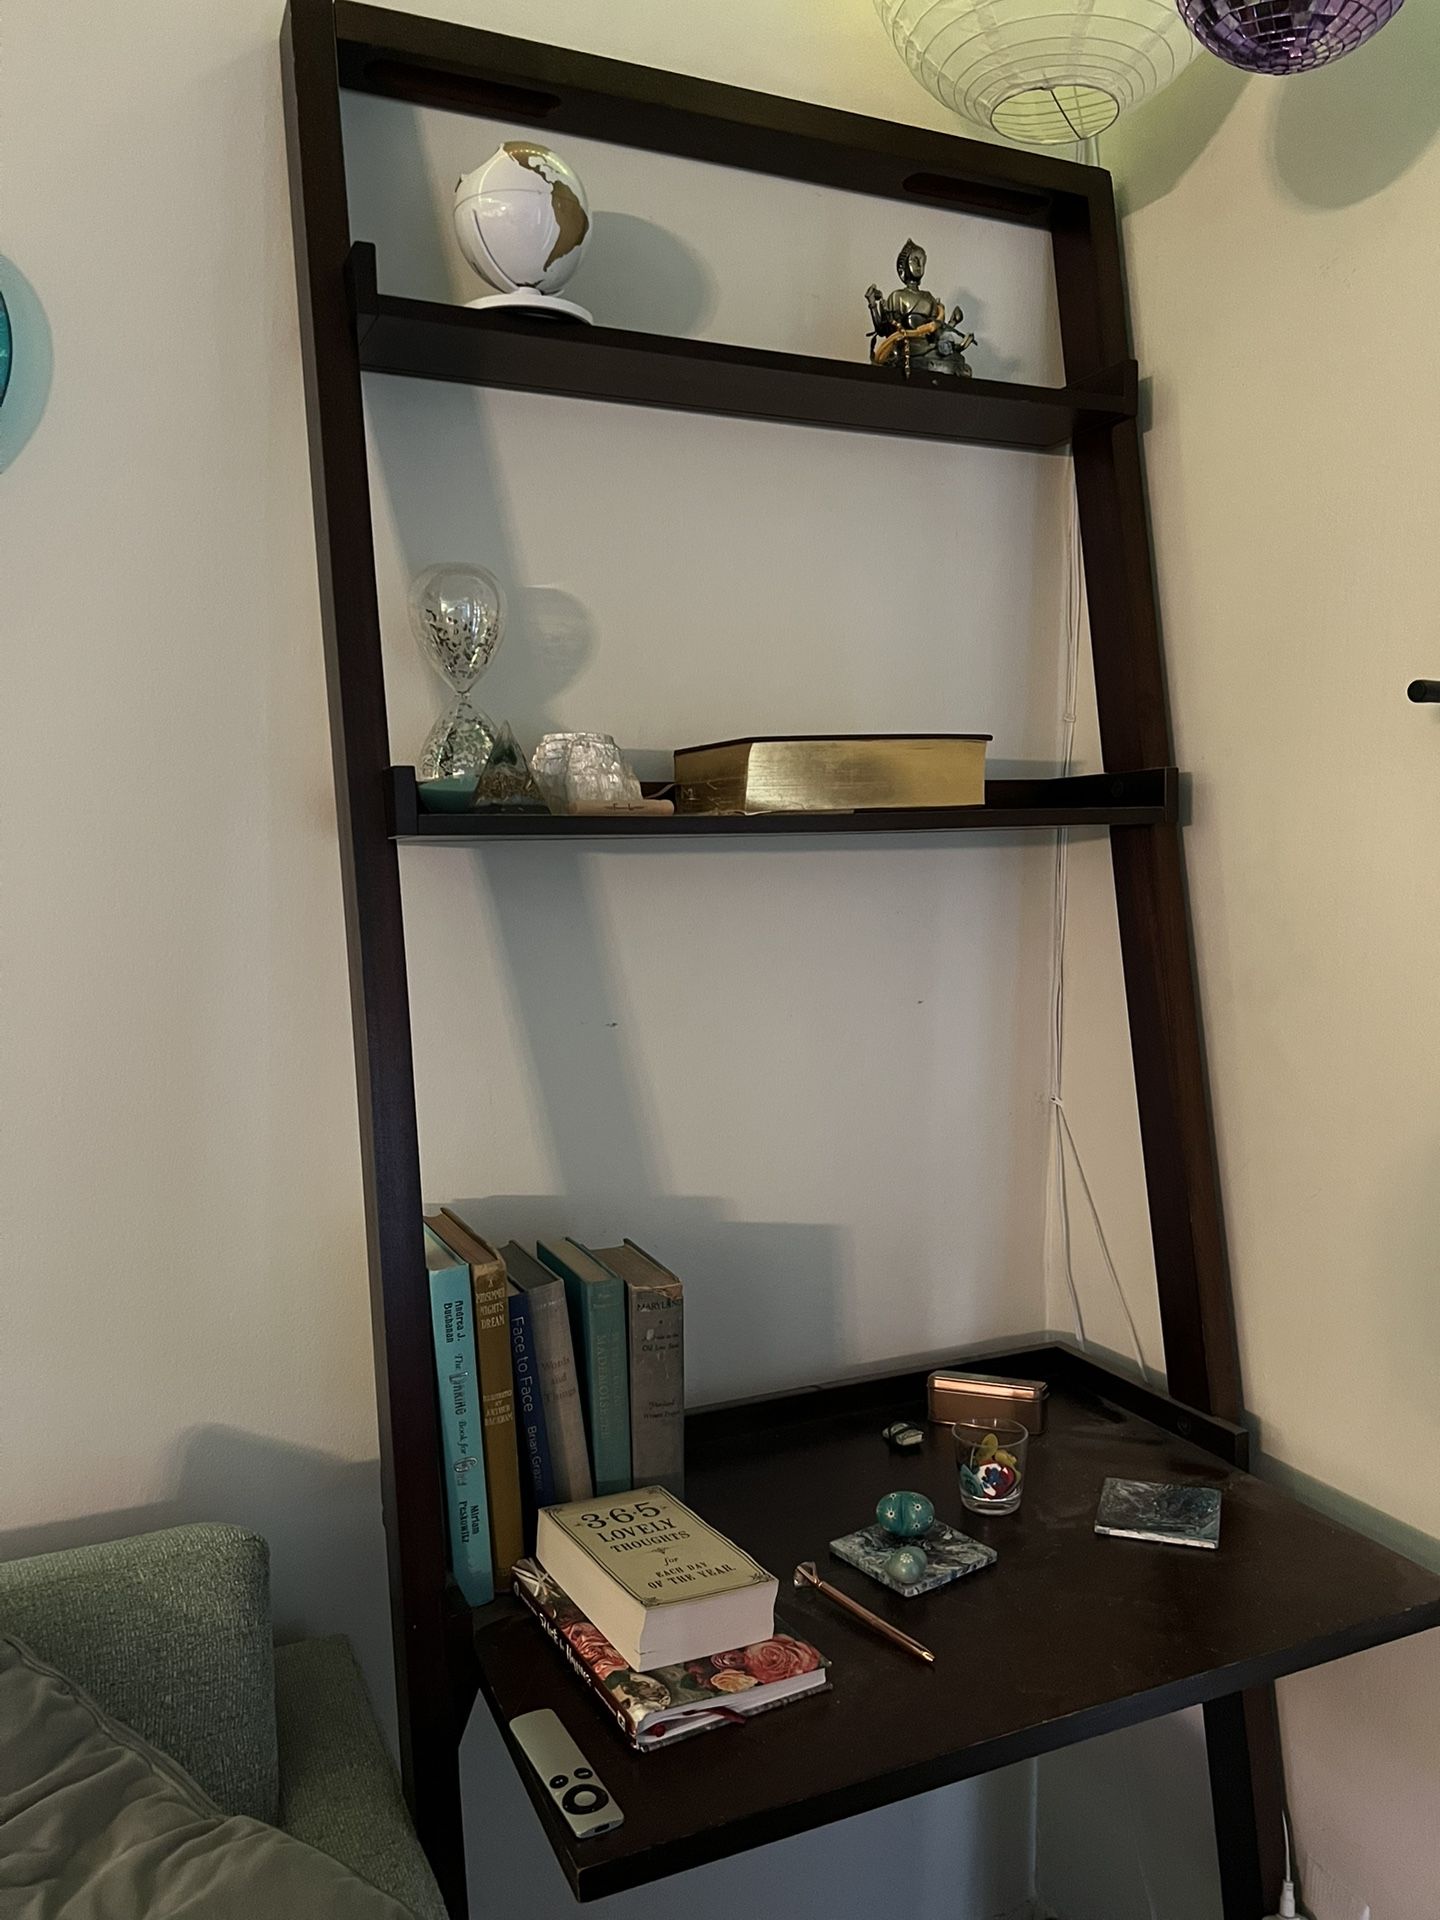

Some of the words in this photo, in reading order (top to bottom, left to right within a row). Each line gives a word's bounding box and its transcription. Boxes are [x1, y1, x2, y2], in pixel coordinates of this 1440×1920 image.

[636, 1299, 683, 1311] MARYLAN
[443, 1302, 454, 1344] Buchanan
[454, 1300, 464, 1331] Andrea
[481, 1314, 505, 1330] DREAM
[457, 1332, 466, 1342] J.
[511, 1315, 526, 1353] Face
[454, 1352, 464, 1369] The
[517, 1356, 528, 1373] to
[541, 1356, 571, 1371] Words
[551, 1372, 567, 1385] and
[519, 1376, 533, 1412] Face
[544, 1386, 577, 1402] Things
[458, 1420, 468, 1440] Book
[457, 1439, 468, 1455] for
[527, 1424, 538, 1455] Brian
[470, 1504, 480, 1535] Miriam
[596, 1518, 677, 1543] LOVELY
[610, 1530, 691, 1553] THOUGHTS
[655, 1566, 685, 1578] EACH
[687, 1560, 708, 1572] DAY
[663, 1556, 679, 1567] for
[647, 1580, 664, 1590] OF
[667, 1572, 696, 1586] THE
